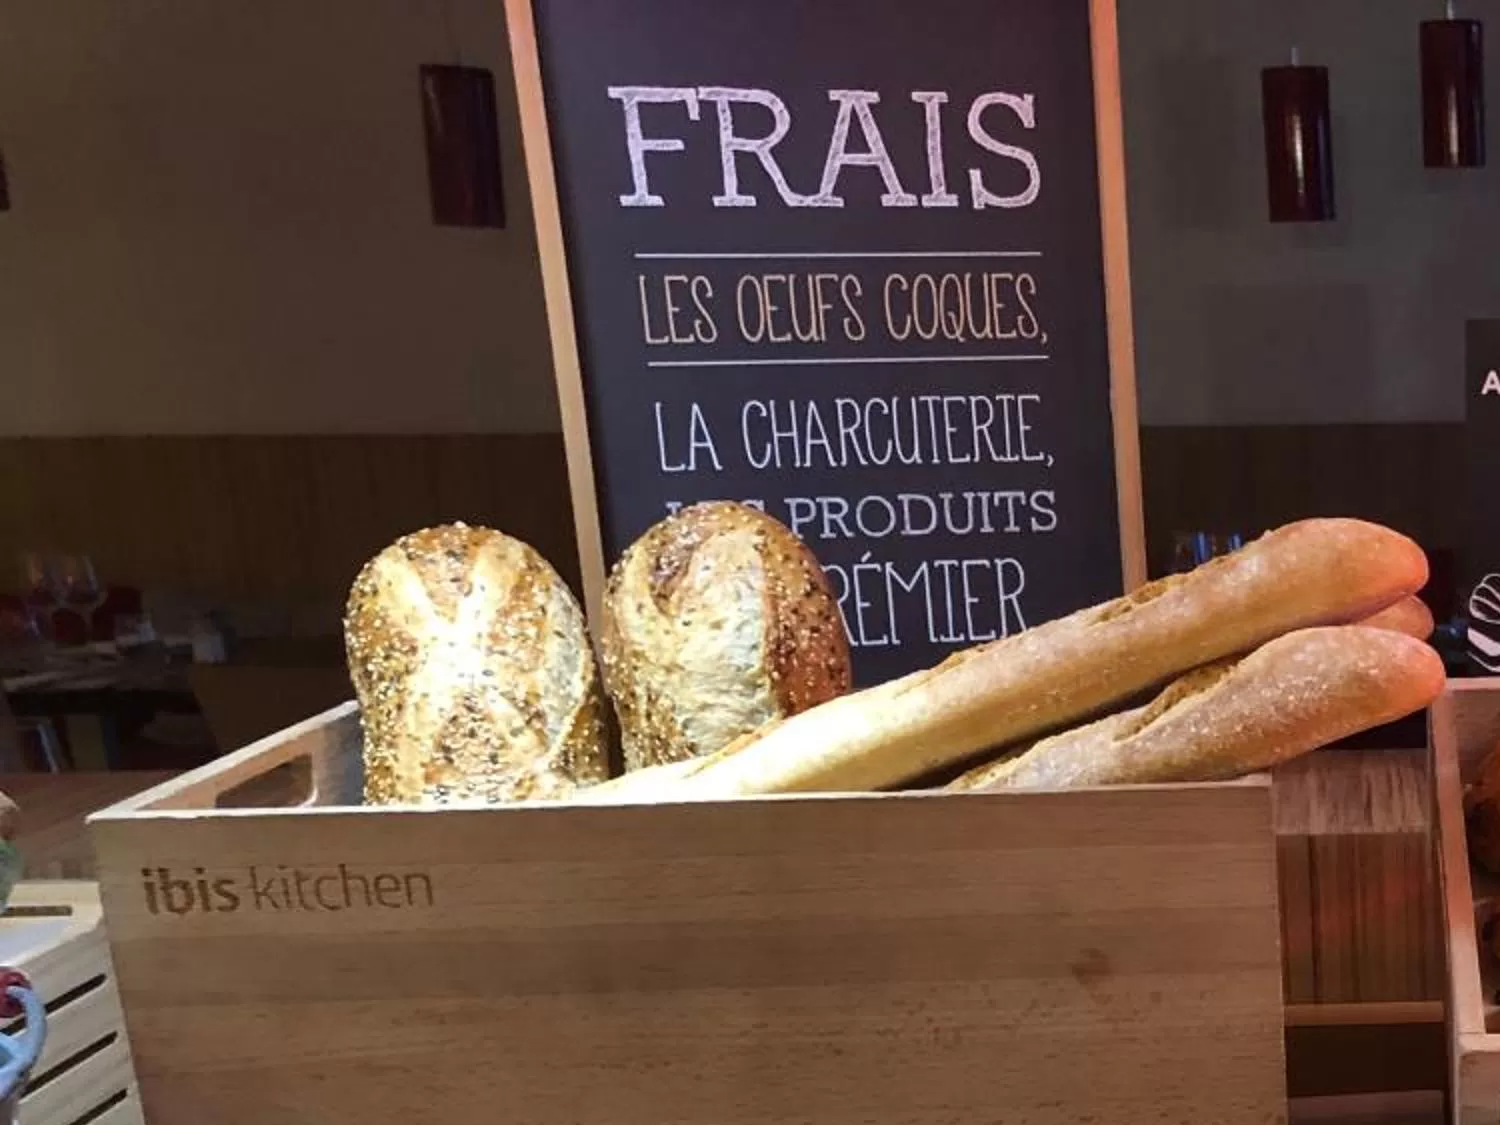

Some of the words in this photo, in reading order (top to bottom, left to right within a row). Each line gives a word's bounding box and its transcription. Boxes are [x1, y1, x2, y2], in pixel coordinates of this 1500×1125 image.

[608, 86, 1040, 208] FRAIS
[639, 274, 718, 345] LES
[884, 271, 1048, 345] COQUES,
[655, 401, 723, 472] LA
[742, 394, 1054, 469] CHARCUTERIE,
[784, 489, 1058, 540] PRODUITS
[822, 552, 1027, 648] RÉMIER
[141, 867, 240, 915] ibis
[248, 863, 434, 912] kitchen
